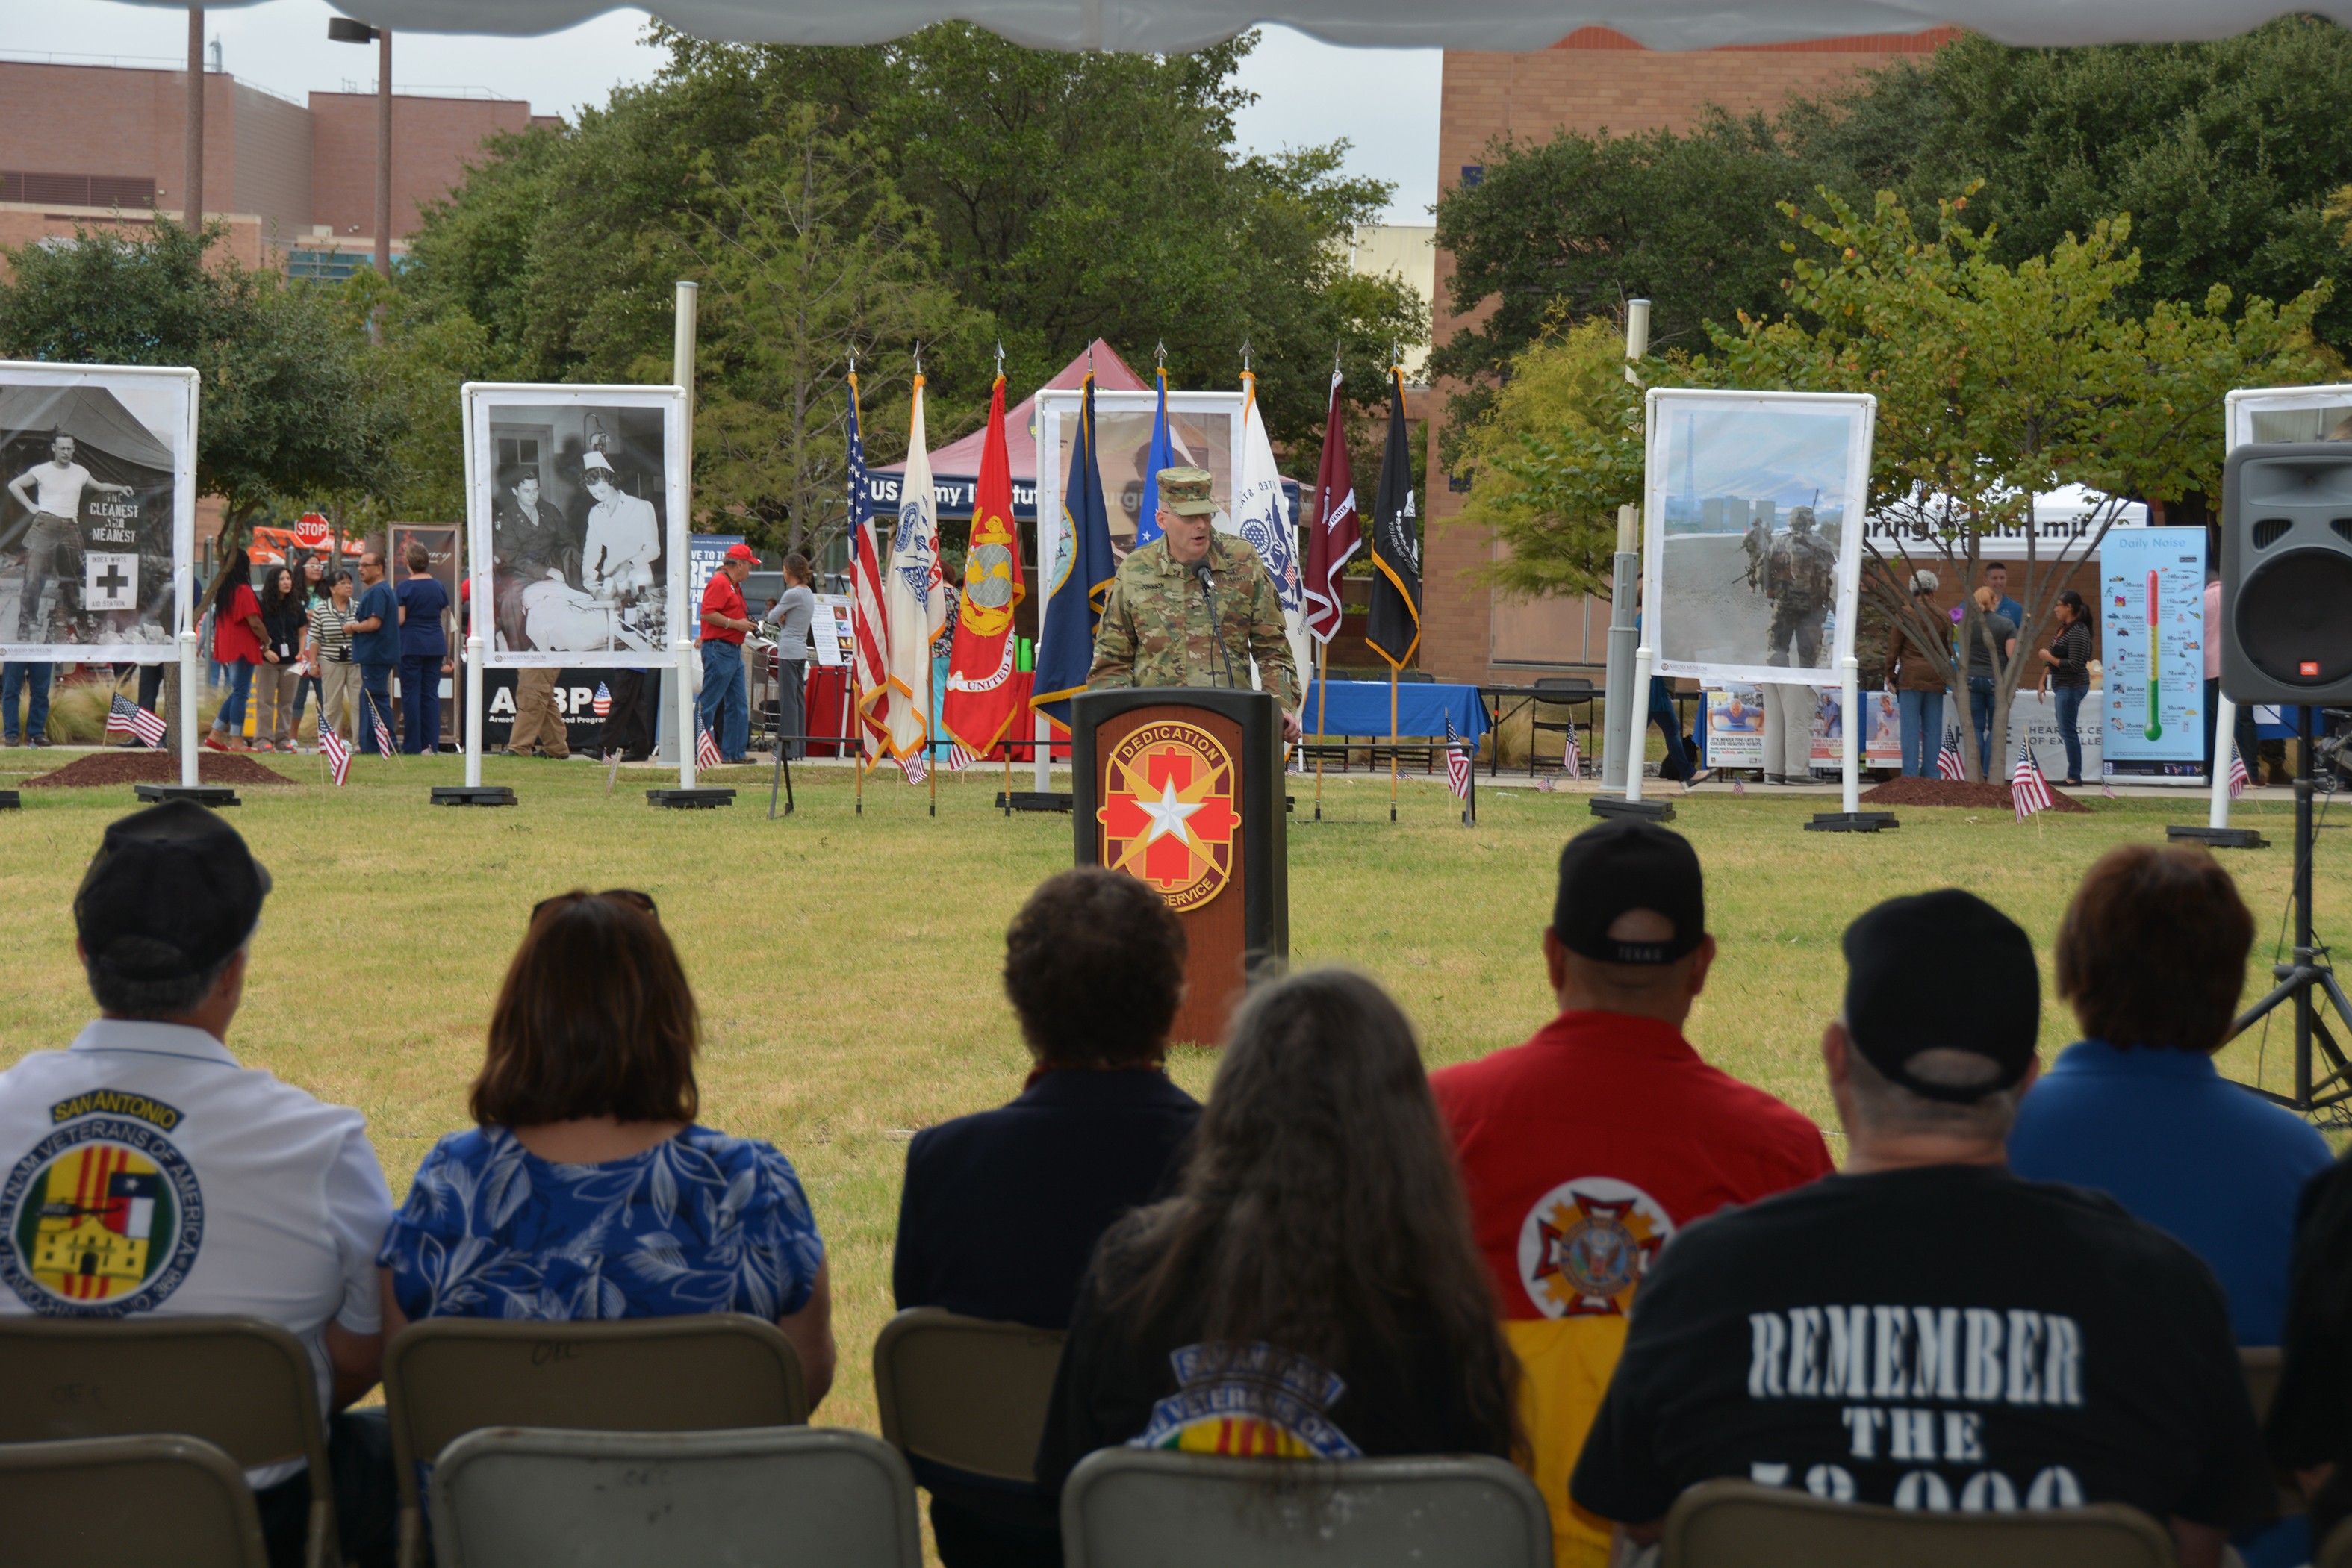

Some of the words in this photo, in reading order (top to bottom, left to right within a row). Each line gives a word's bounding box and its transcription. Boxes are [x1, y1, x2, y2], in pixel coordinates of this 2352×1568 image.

[871, 480, 898, 501] US
[933, 487, 962, 507] my
[90, 503, 140, 518] CLEANEST
[92, 528, 137, 543] MEANEST
[297, 523, 326, 536] STOP
[704, 550, 715, 560] TO
[2119, 538, 2149, 550] Daily
[2153, 538, 2185, 547] Noise
[968, 662, 1010, 691] UNITED
[489, 686, 593, 715] ABP
[489, 715, 515, 724] Armed
[577, 716, 606, 724] Progra
[2029, 727, 2083, 735] HEARG
[1121, 727, 1219, 761] DEDICATION
[2029, 737, 2045, 745] OF
[1162, 877, 1215, 907] SERVICE
[54, 1094, 93, 1121] SAN
[93, 1090, 177, 1130] ANTONIO
[40, 1120, 149, 1156] VETERANS
[149, 1139, 178, 1163] OF
[169, 1165, 201, 1256] AMERICA
[1748, 1304, 2084, 1405] REMEMBER
[1841, 1407, 1985, 1462] THE
